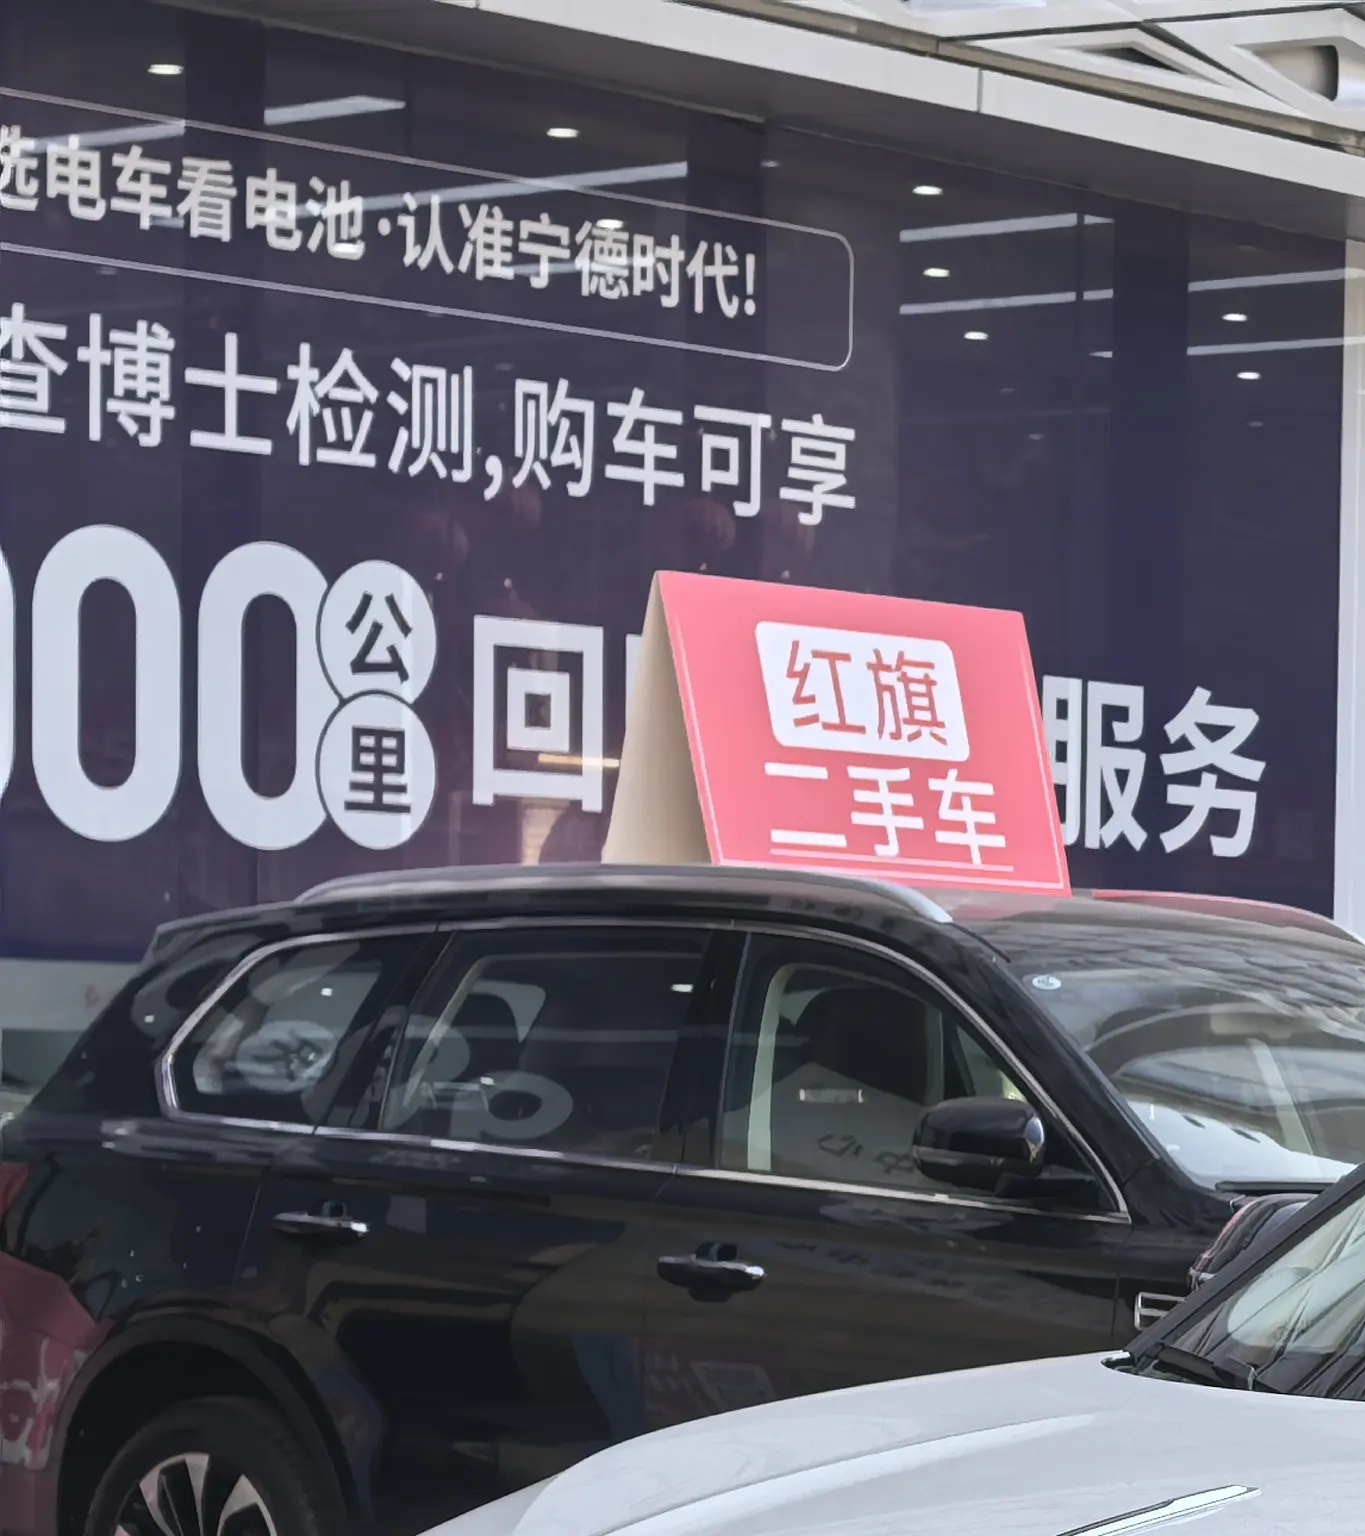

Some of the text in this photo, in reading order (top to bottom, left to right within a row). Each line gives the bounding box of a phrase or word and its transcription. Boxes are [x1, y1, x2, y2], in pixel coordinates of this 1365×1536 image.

[0, 523, 328, 851] 00
[785, 640, 949, 747] 红旗
[764, 762, 1006, 866] 二手车
